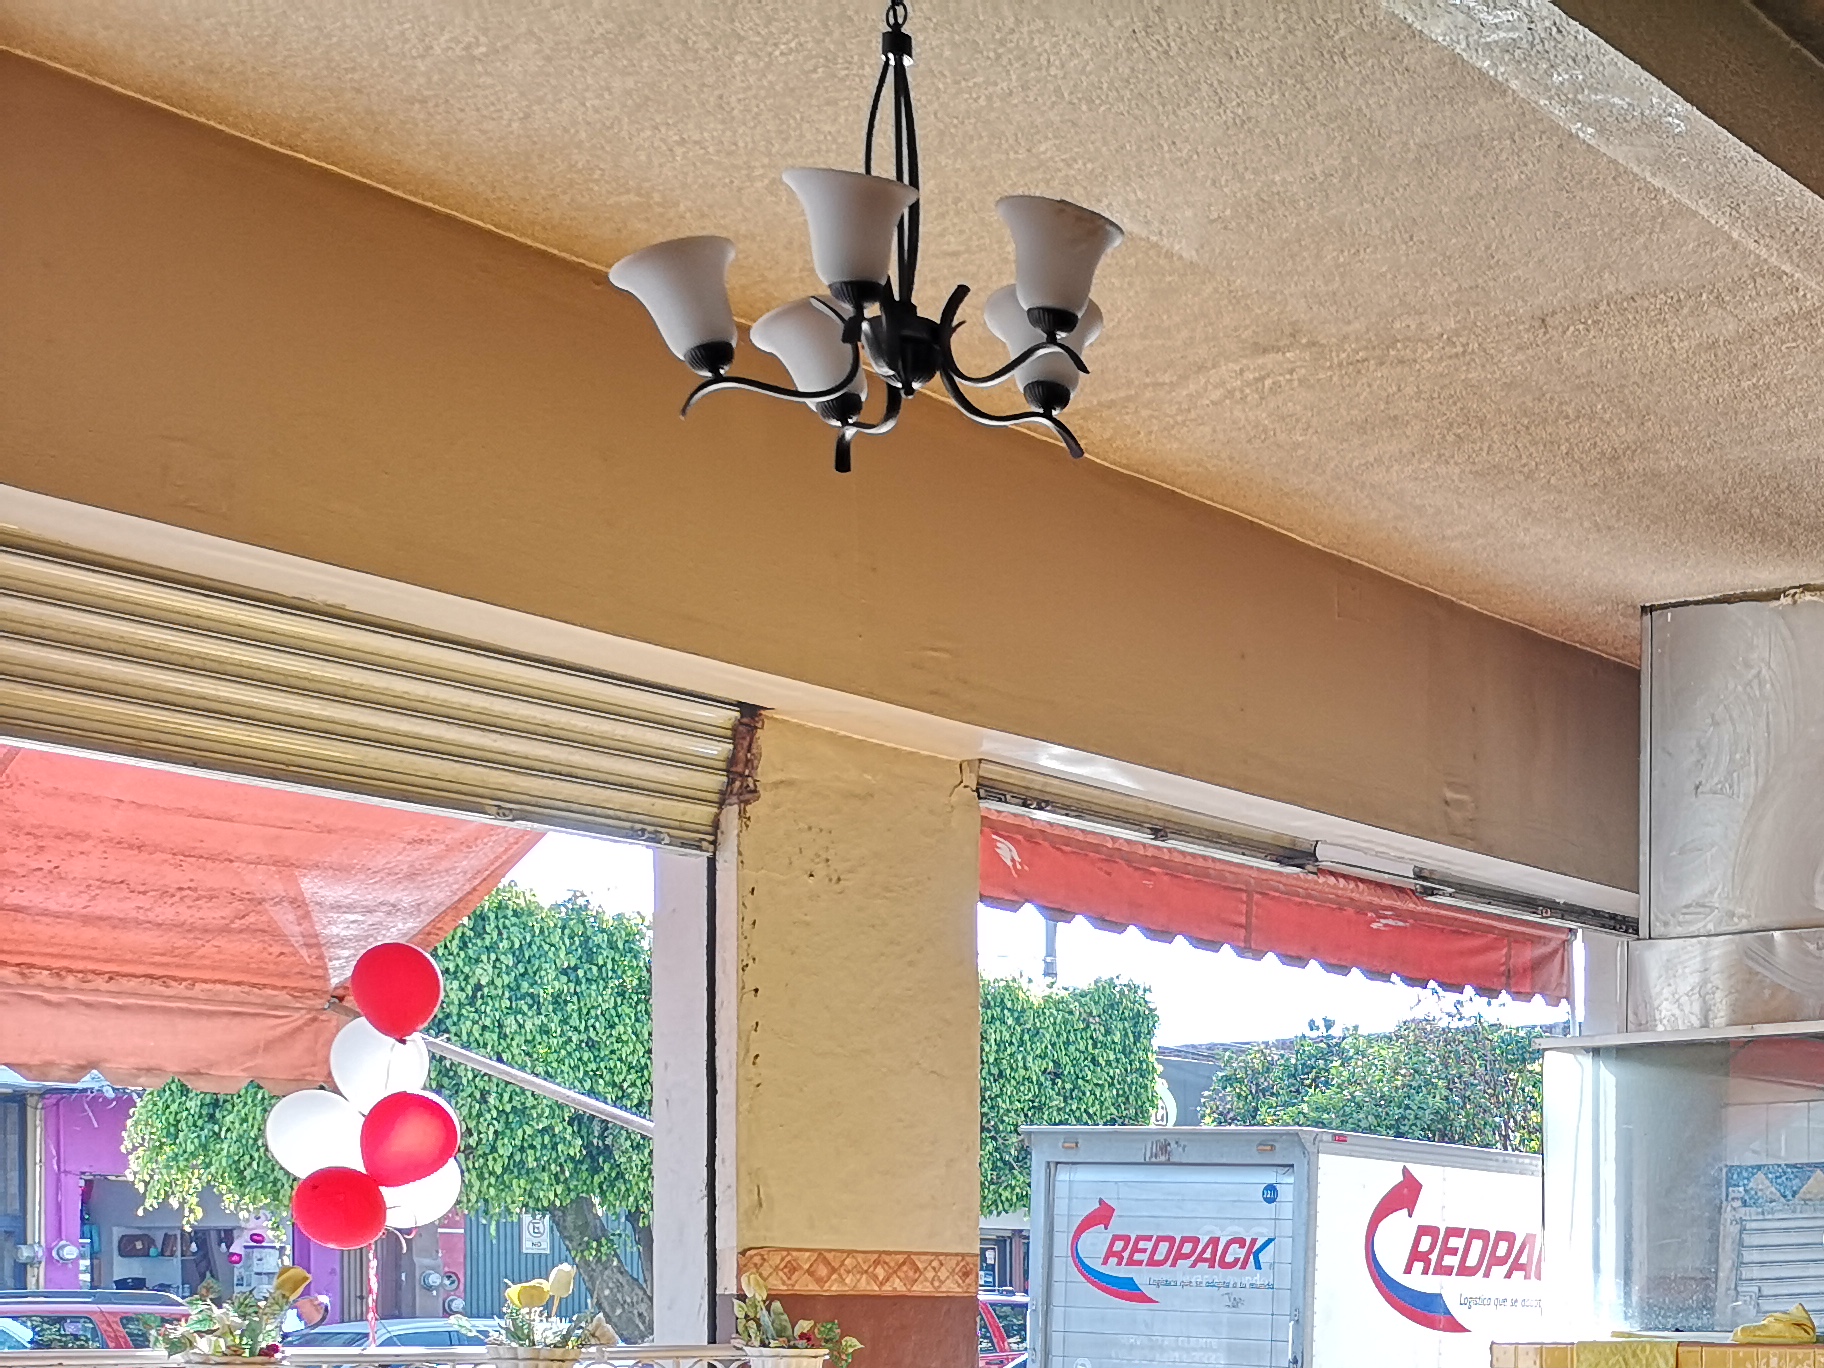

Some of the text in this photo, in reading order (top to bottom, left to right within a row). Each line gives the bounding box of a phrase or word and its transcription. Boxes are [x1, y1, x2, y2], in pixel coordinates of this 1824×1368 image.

[1101, 1234, 1276, 1270] REDPACK
[1403, 1224, 1542, 1281] REDPA
[1494, 1297, 1508, 1310] que
[1510, 1298, 1518, 1307] se
